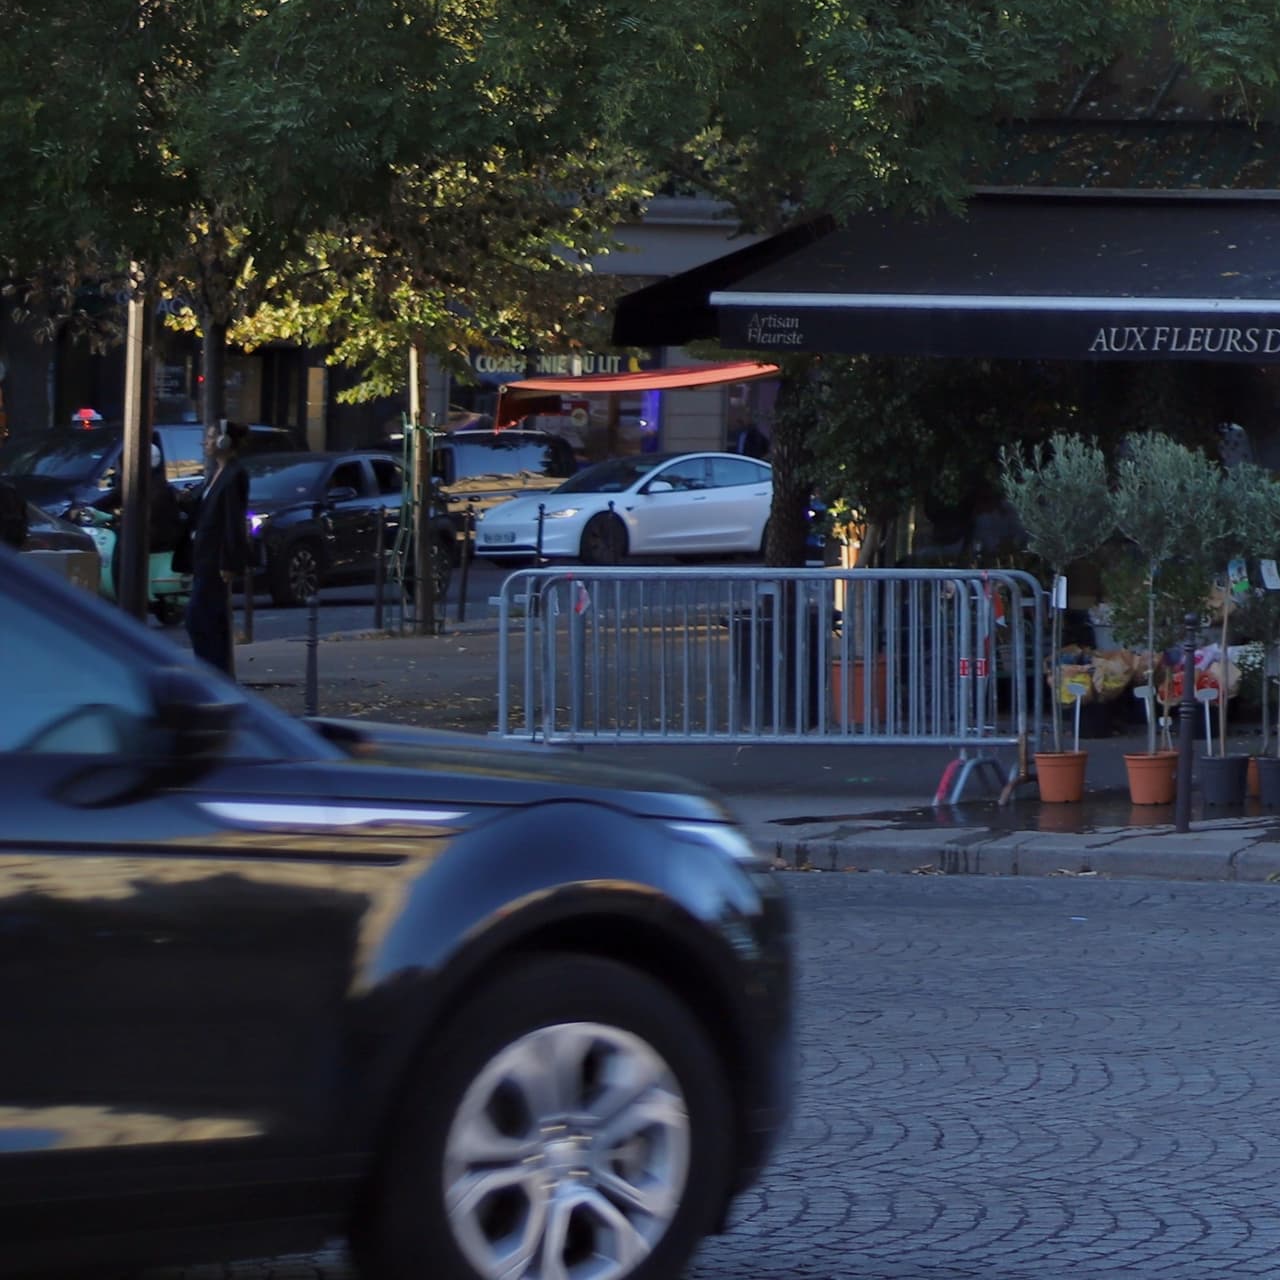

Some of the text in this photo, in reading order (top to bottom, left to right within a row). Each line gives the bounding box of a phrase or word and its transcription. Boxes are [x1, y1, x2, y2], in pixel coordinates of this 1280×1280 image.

[745, 312, 800, 328] Artisan
[746, 328, 804, 344] Fleuriste
[1088, 326, 1150, 353] AUX
[1152, 327, 1260, 354] FLEURS
[598, 355, 621, 374] LIT
